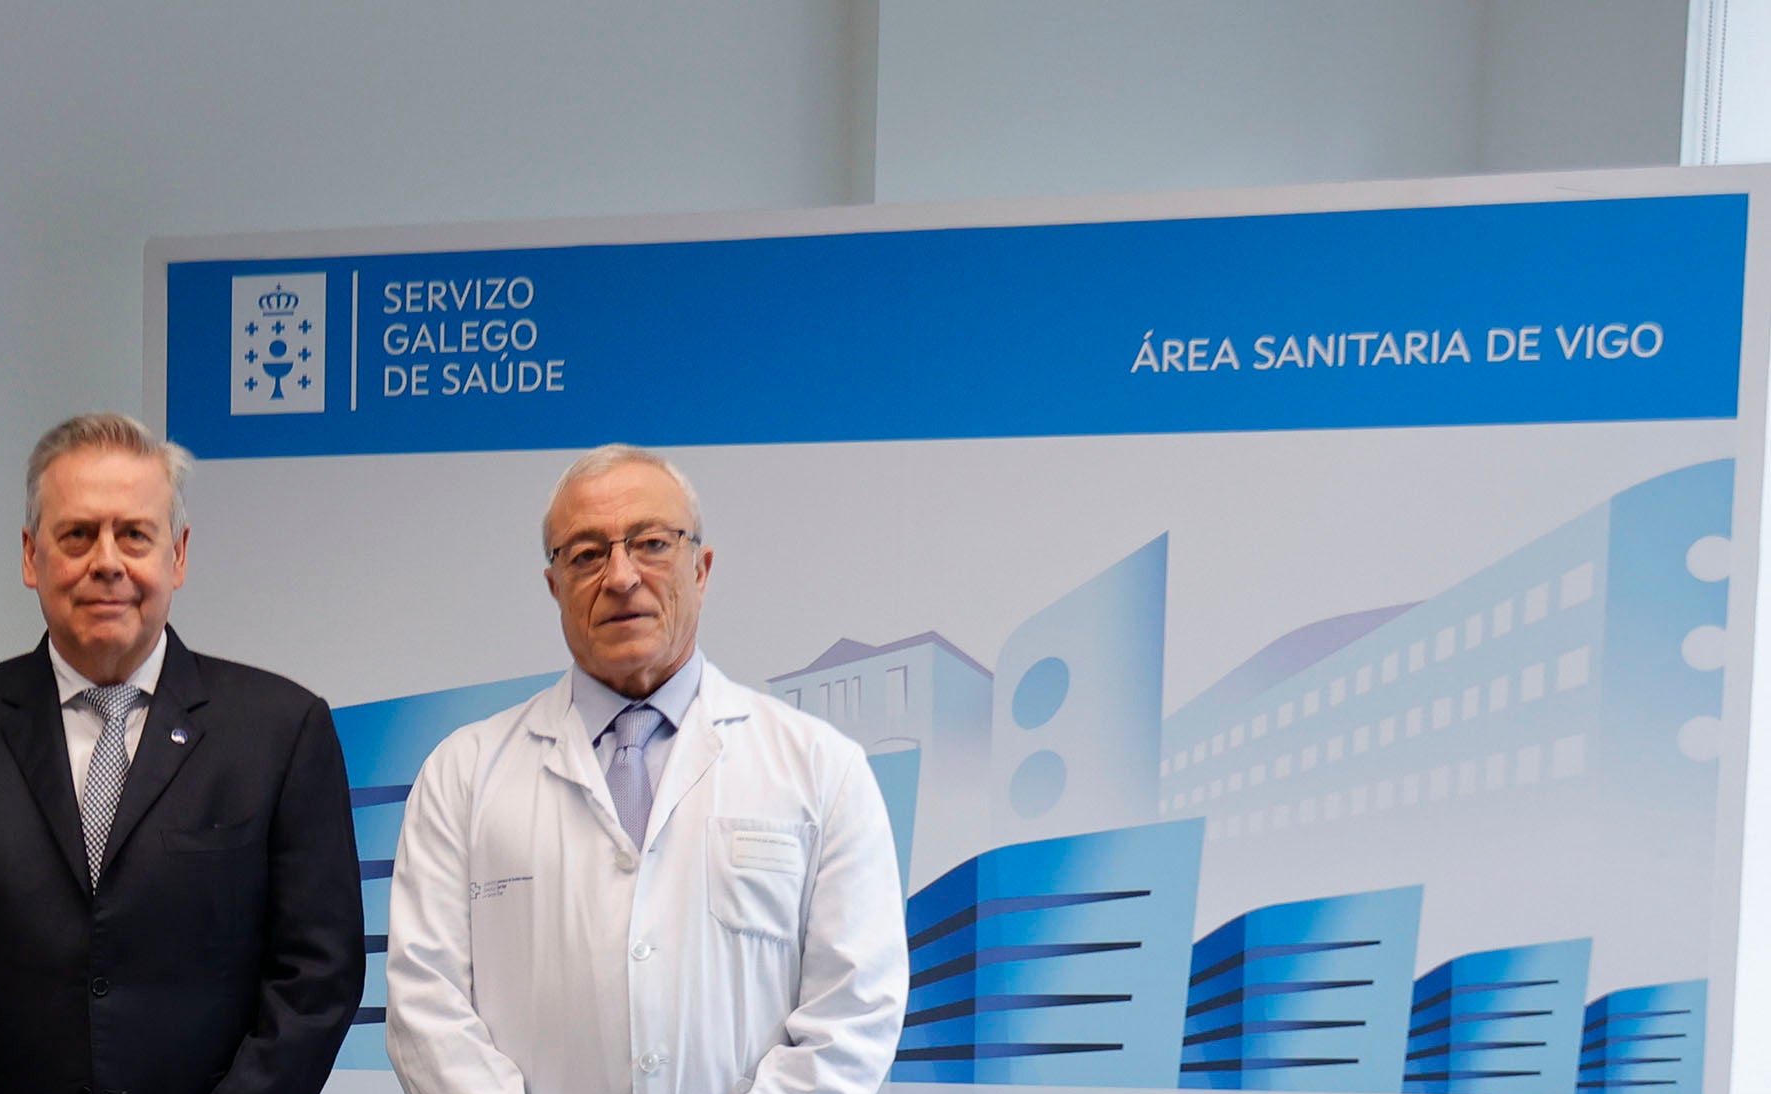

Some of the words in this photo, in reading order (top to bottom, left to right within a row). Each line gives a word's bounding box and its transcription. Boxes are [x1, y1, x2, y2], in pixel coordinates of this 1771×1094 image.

[383, 276, 534, 314] SERVIZO
[383, 318, 538, 355] GALEGO
[1130, 329, 1240, 373] ÁREA
[1253, 330, 1471, 370] SANITARIA
[1486, 326, 1542, 363] DE
[1555, 322, 1664, 360] VIGO
[383, 364, 429, 397] DE
[439, 351, 565, 396] SAÚDE
